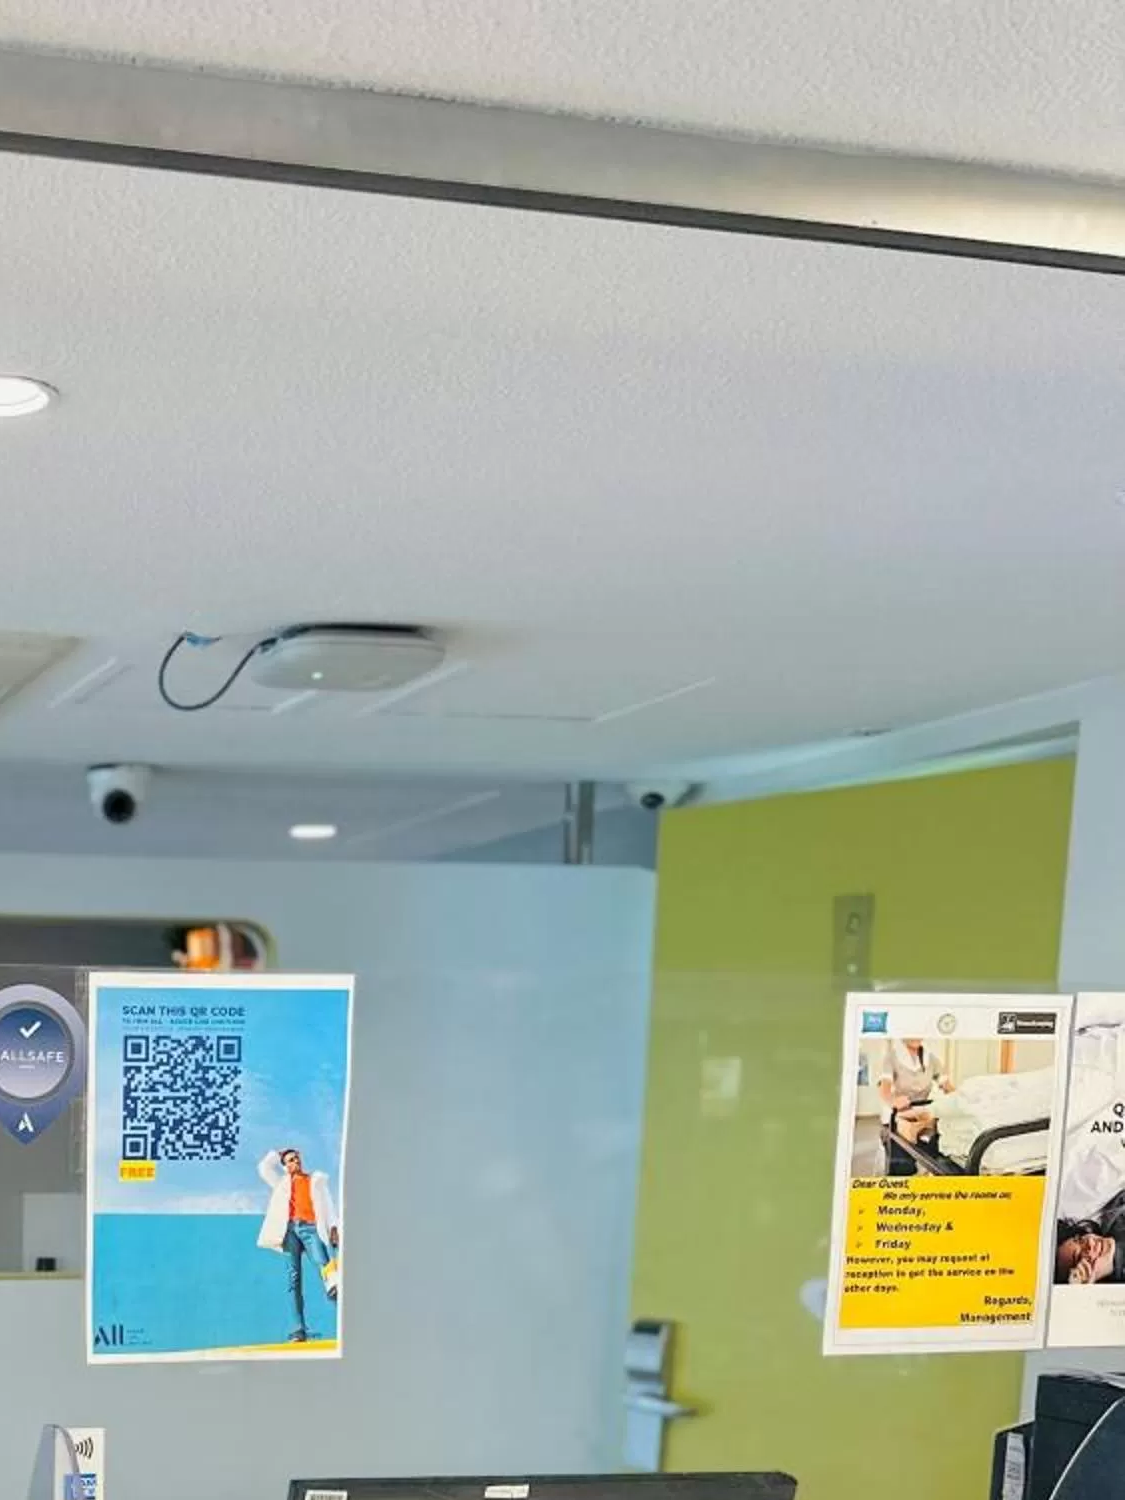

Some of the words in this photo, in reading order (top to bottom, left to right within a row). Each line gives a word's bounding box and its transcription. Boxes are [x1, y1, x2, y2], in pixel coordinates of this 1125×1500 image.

[122, 1005, 156, 1015] SCAN
[159, 1005, 186, 1016] THIS
[190, 1006, 208, 1017] QR
[210, 1006, 246, 1017] CODE
[1091, 1121, 1124, 1133] AND
[852, 1179, 876, 1189] Dear
[878, 1179, 909, 1190] Guest,
[899, 1192, 917, 1202] only
[919, 1192, 953, 1200] service
[954, 1191, 969, 1200] the
[878, 1206, 926, 1217] Monday,
[876, 1223, 942, 1233] Wednesday
[945, 1222, 954, 1231] &
[875, 1239, 911, 1250] Friday
[846, 1256, 894, 1266] However,
[896, 1257, 914, 1265] you
[916, 1256, 938, 1265] may
[940, 1254, 977, 1265] request
[845, 1270, 893, 1279] reception
[909, 1270, 925, 1279] get
[928, 1269, 943, 1277] the
[946, 1269, 982, 1277] service
[998, 1268, 1014, 1276] the
[844, 1283, 870, 1293] other
[984, 1296, 1032, 1306] Regards,
[960, 1312, 1032, 1324] Management
